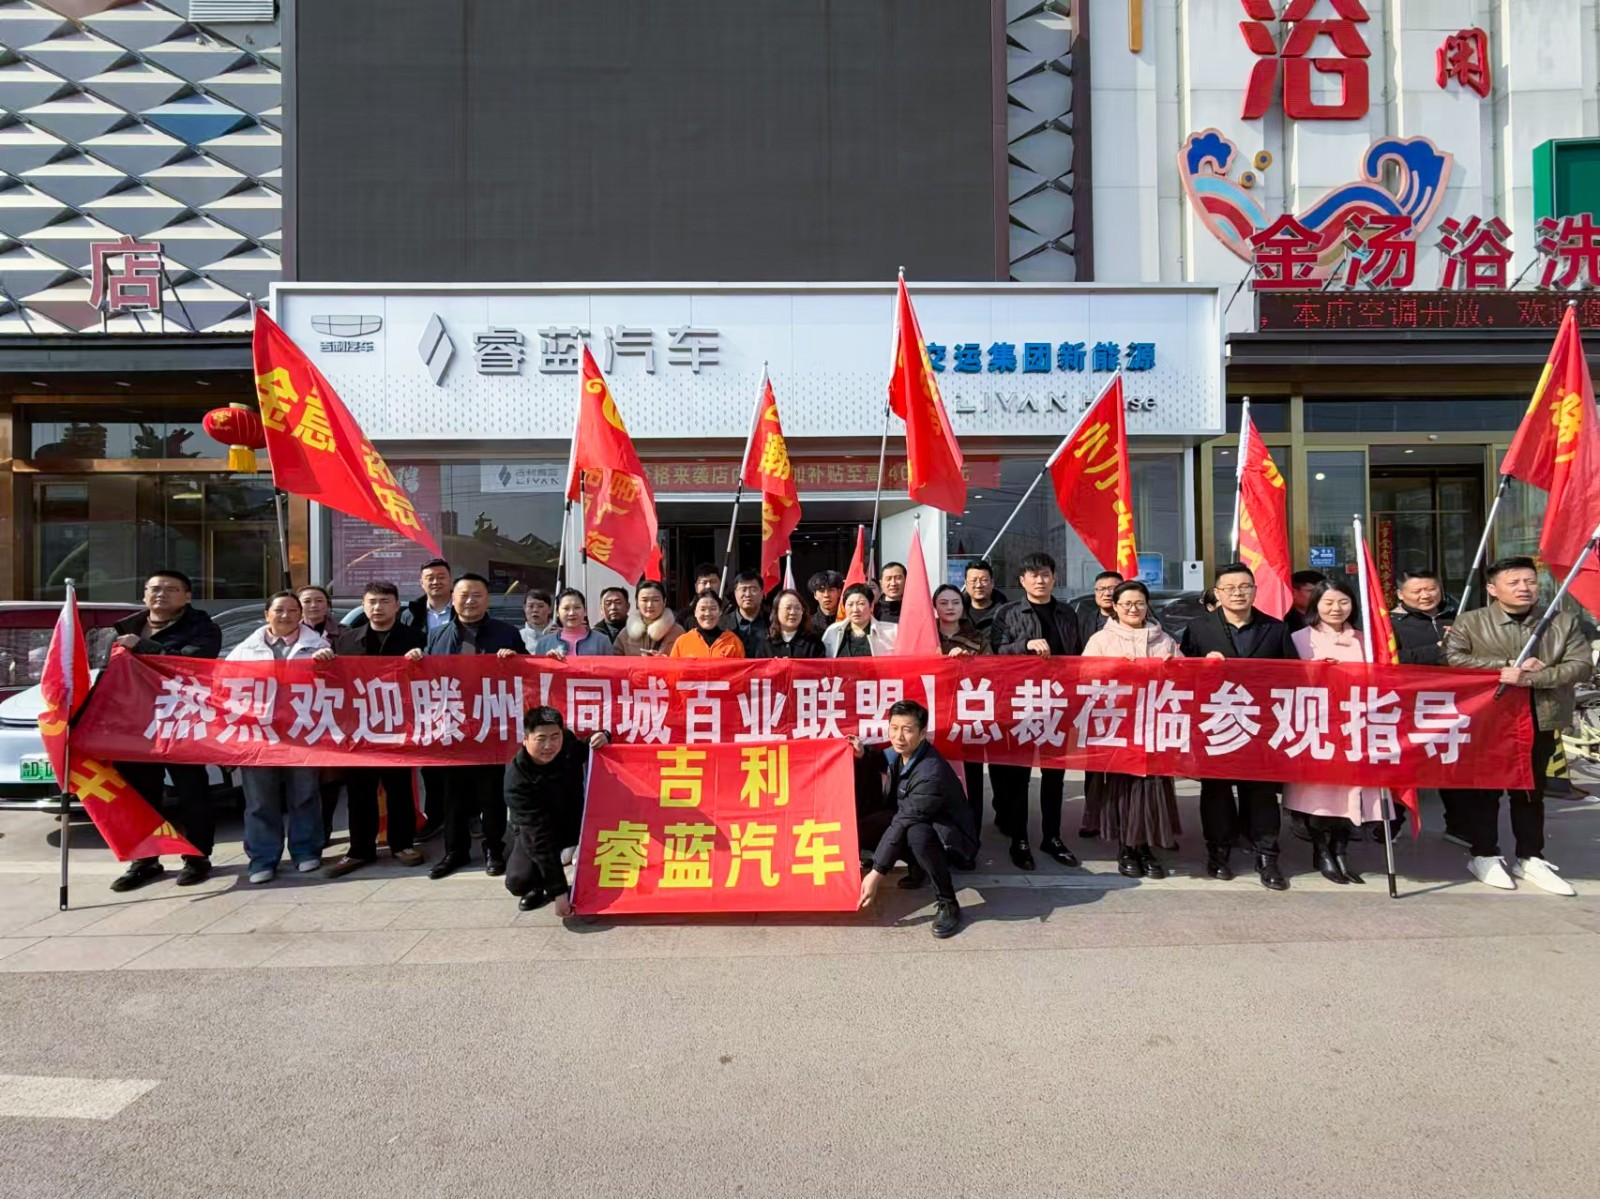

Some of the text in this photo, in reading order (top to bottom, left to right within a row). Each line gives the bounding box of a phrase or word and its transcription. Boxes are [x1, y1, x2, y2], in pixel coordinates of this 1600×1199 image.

[1239, 0, 1370, 120] 浴
[87, 234, 163, 312] 店
[1249, 211, 1600, 292] 金汤浴洗
[472, 324, 720, 376] 睿蓝汽车
[925, 341, 1156, 373] 交运集团新能源
[955, 391, 1068, 413] LIVAN
[594, 819, 846, 889] 睿蓝汽车
